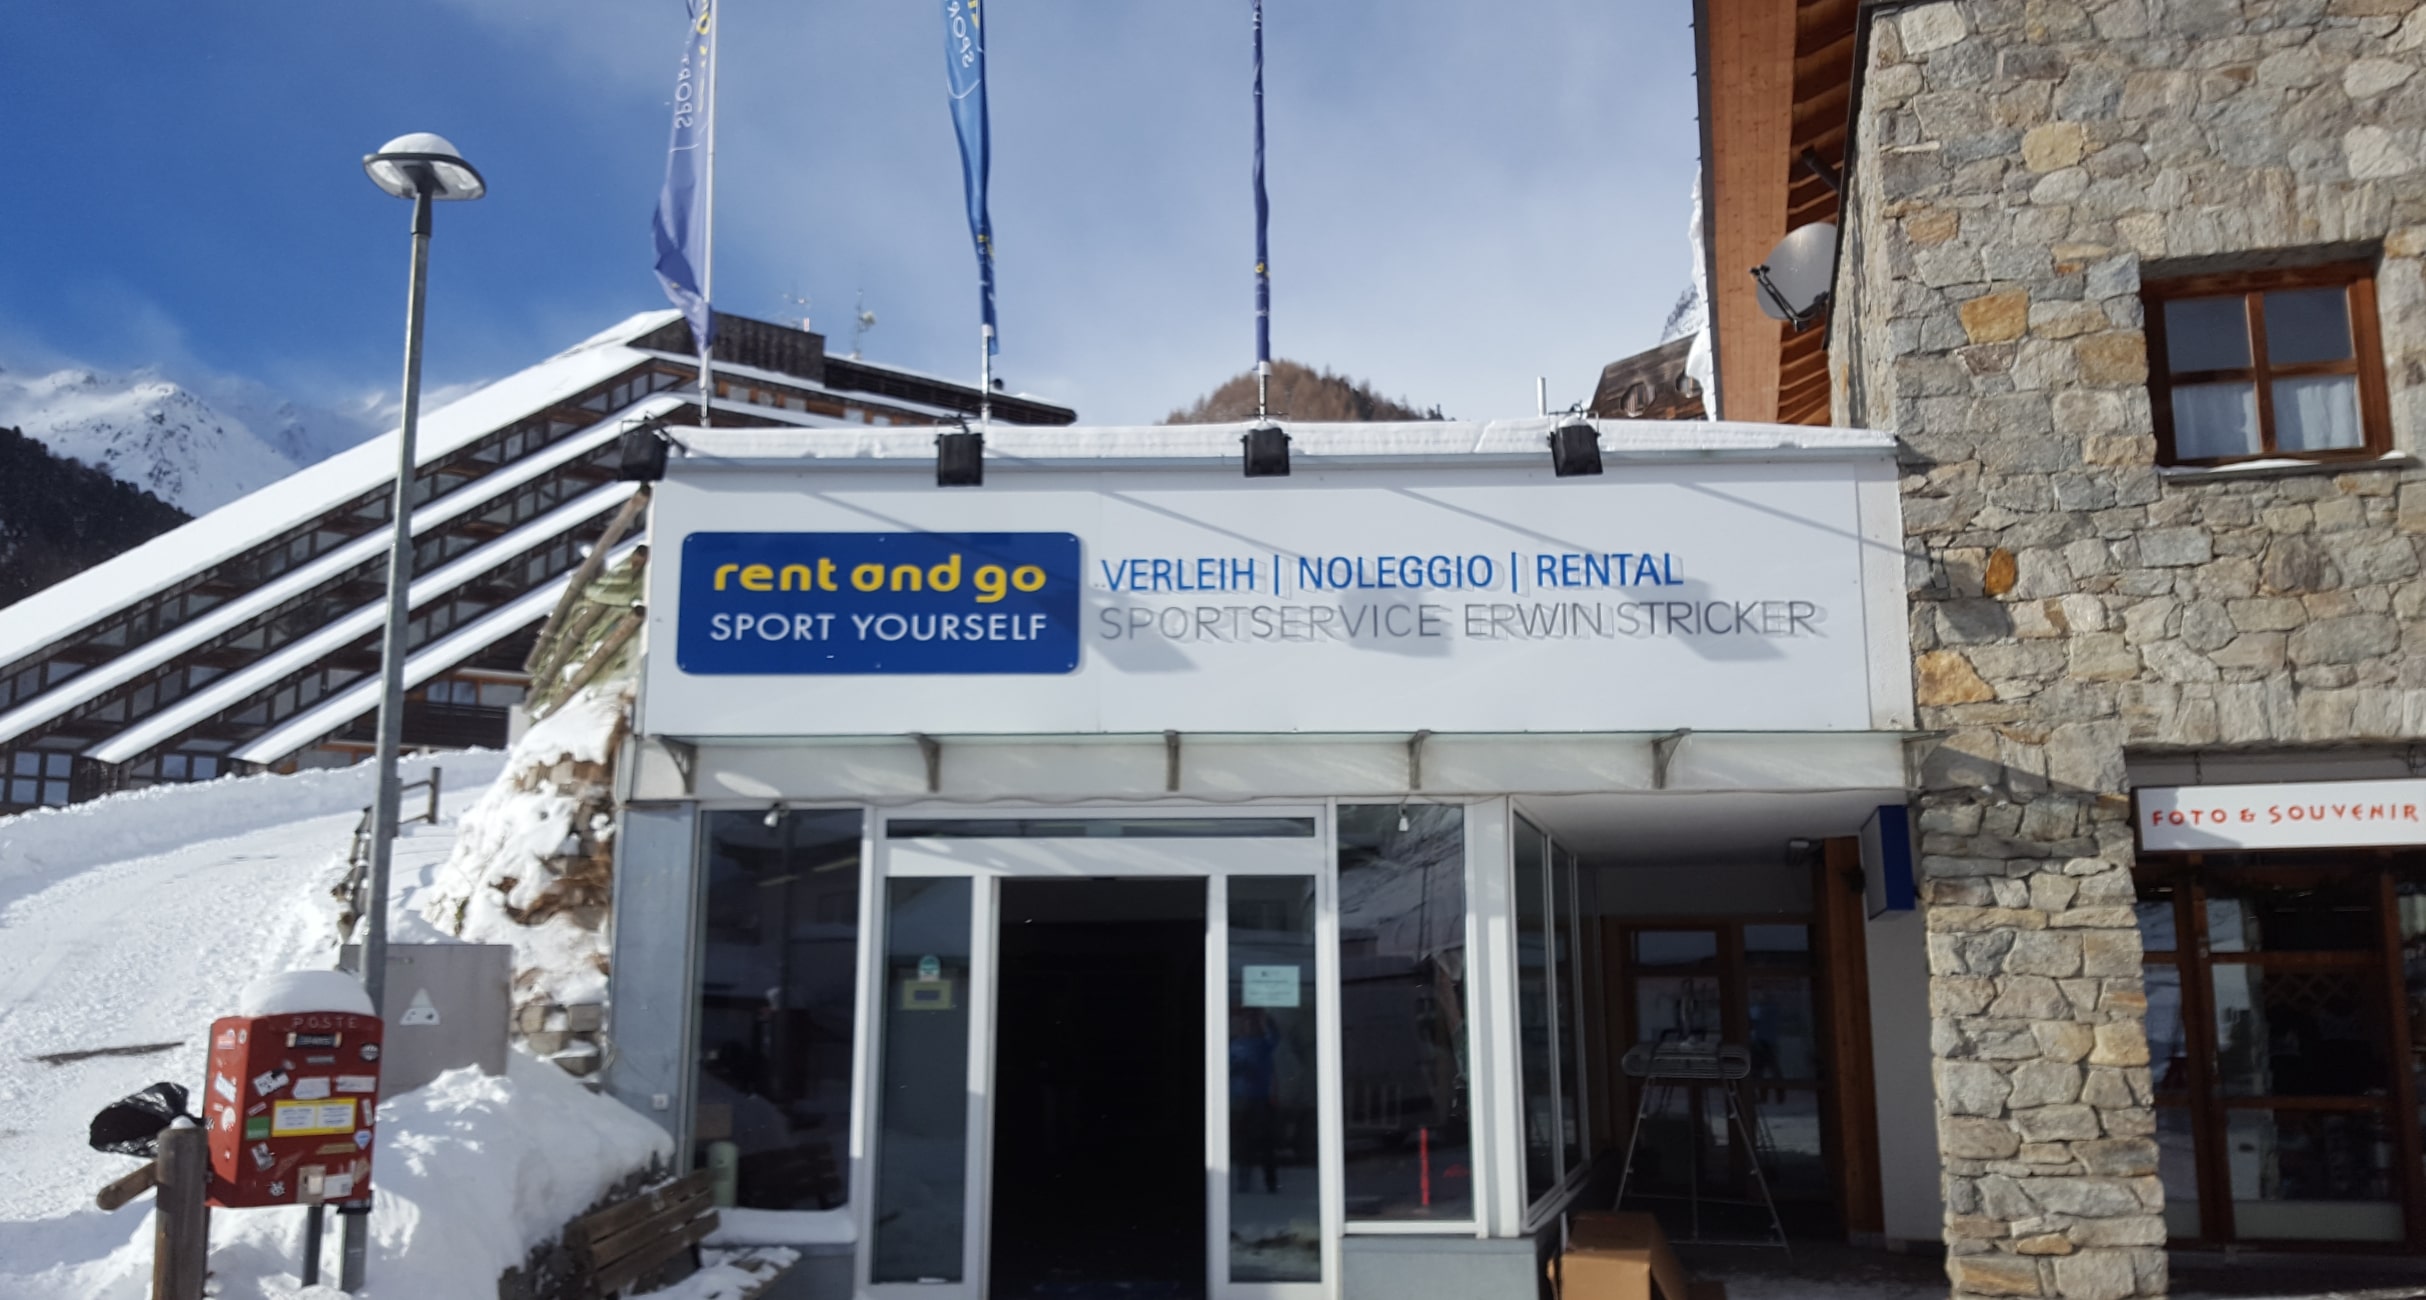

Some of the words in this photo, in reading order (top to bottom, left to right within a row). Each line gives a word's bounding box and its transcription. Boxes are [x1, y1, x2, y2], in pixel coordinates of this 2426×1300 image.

[713, 557, 838, 592] rent
[850, 554, 961, 592] and
[973, 565, 1047, 603] go
[1100, 557, 1254, 591] VERLEIH
[1298, 555, 1493, 589] NOLEGGIO
[1536, 552, 1683, 587] RENTAL
[709, 613, 836, 642] SPORT
[851, 613, 1048, 641] YOURSELF
[1099, 604, 1442, 640] SPORTSERVICE
[1464, 603, 1602, 637] ERWIN
[1616, 601, 1816, 635] STRICKER
[2152, 809, 2227, 826] FOTO
[2240, 809, 2255, 822] &
[2269, 803, 2419, 824] SOUVENIR
[292, 1016, 358, 1029] POSTE
